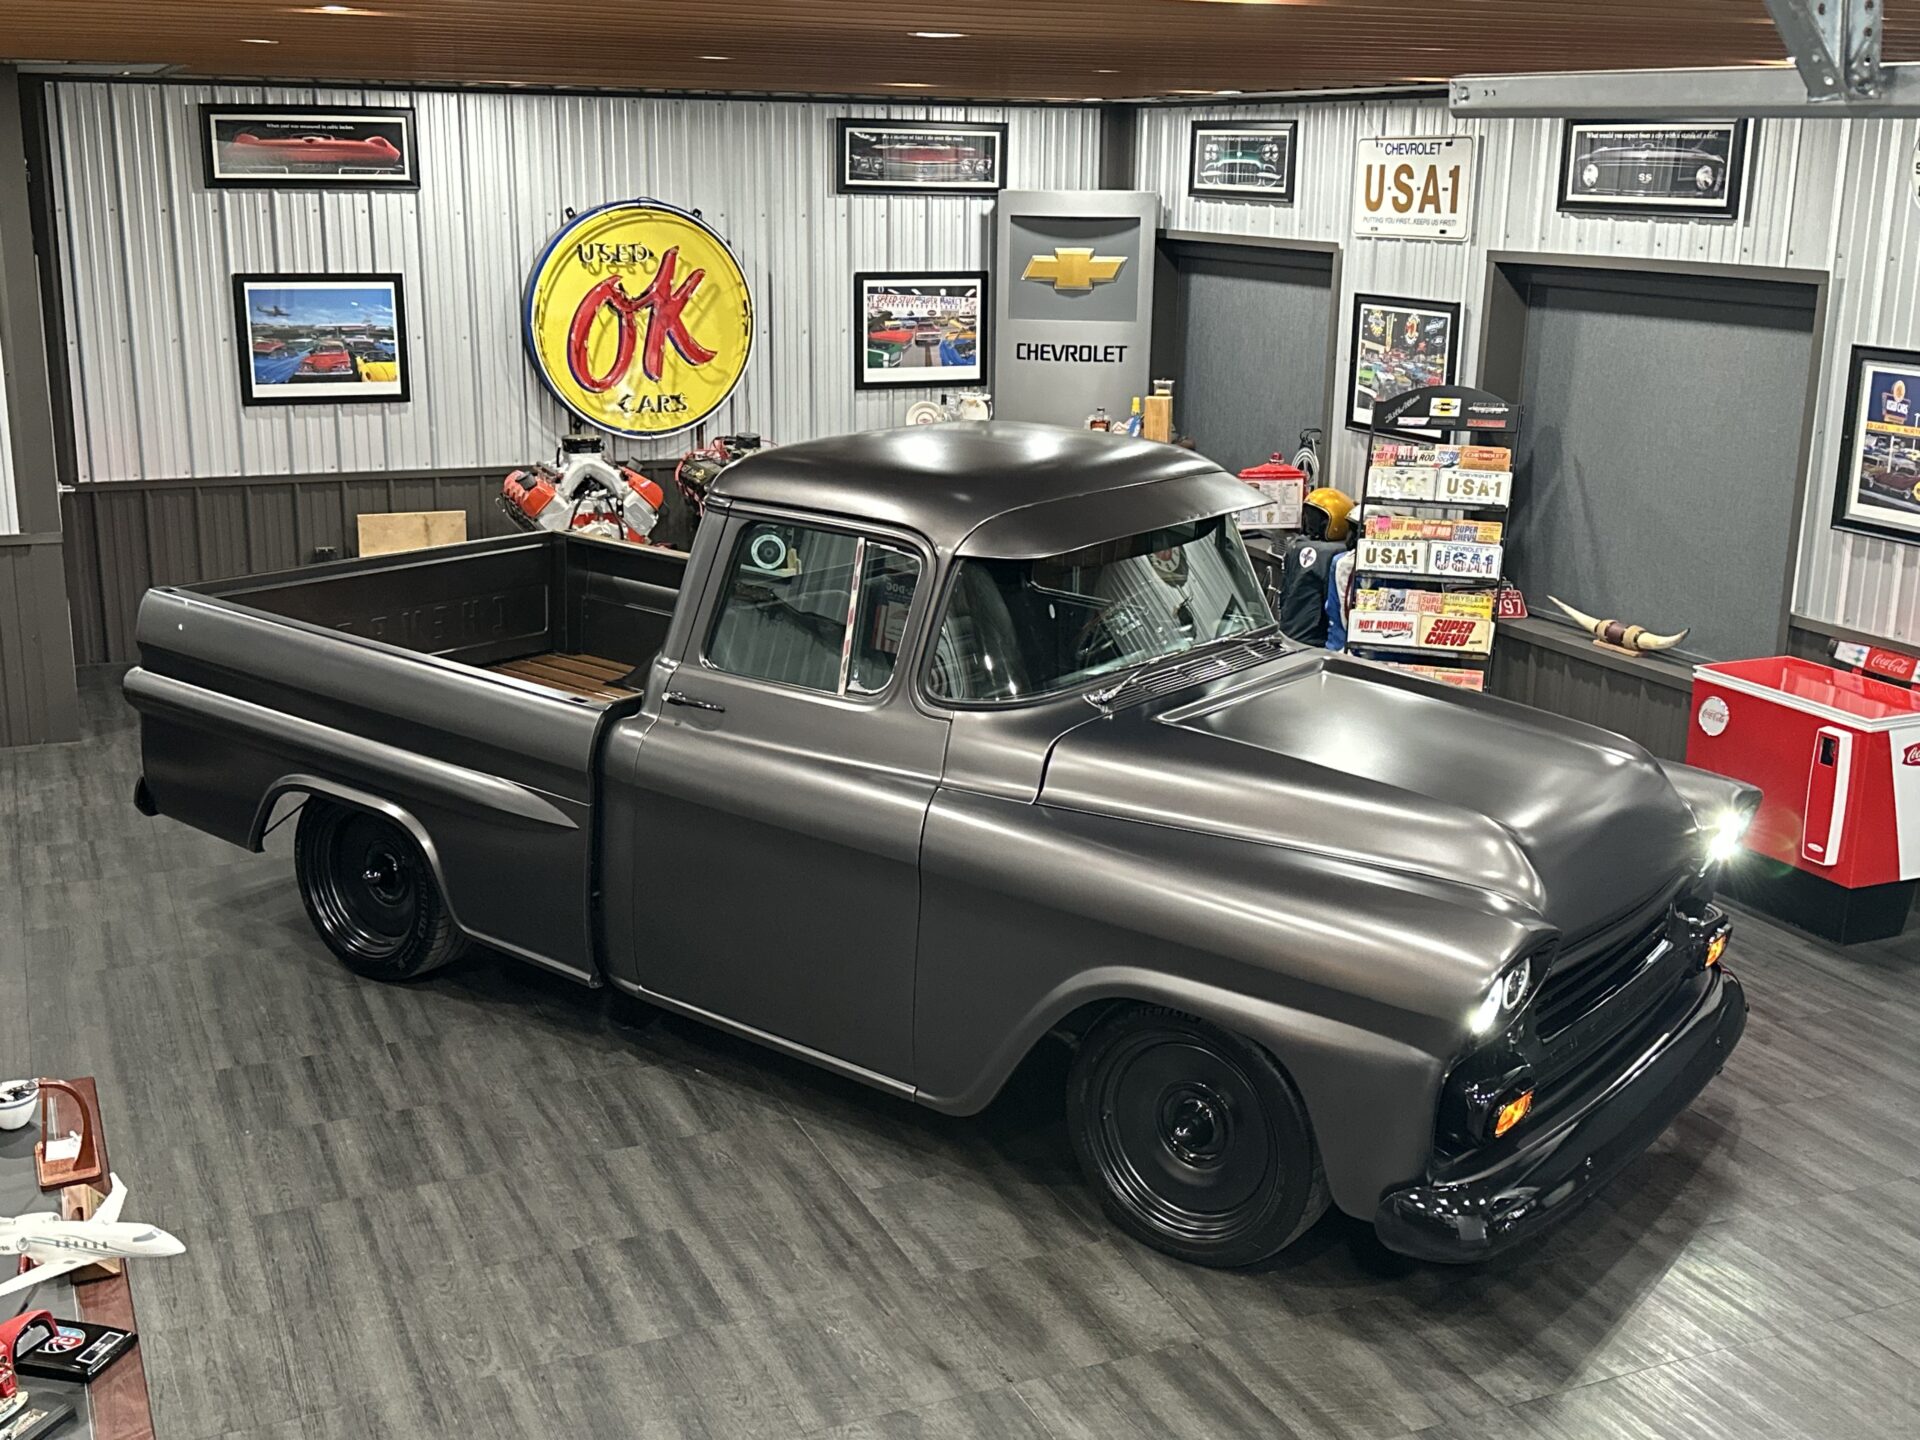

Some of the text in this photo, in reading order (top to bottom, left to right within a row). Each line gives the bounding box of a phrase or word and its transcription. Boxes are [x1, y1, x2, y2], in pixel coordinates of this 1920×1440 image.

[1385, 142, 1442, 155] CHEVROLET
[577, 243, 652, 264] USED
[876, 295, 898, 304] SPEED
[566, 245, 718, 394] OK
[1016, 342, 1128, 363] CHEVROLET
[617, 393, 689, 414] CARS
[1419, 452, 1435, 461] ROD
[1463, 451, 1504, 460] CHEVROLET
[1455, 525, 1479, 534] SUPER
[1453, 533, 1477, 542] CHEVY
[1447, 544, 1483, 553] CHEVROLET
[1443, 592, 1484, 603] CHRYSLER
[1358, 619, 1414, 631] HOT RODDING
[1431, 618, 1476, 634] SUPER
[1424, 632, 1470, 647] CHEVY
